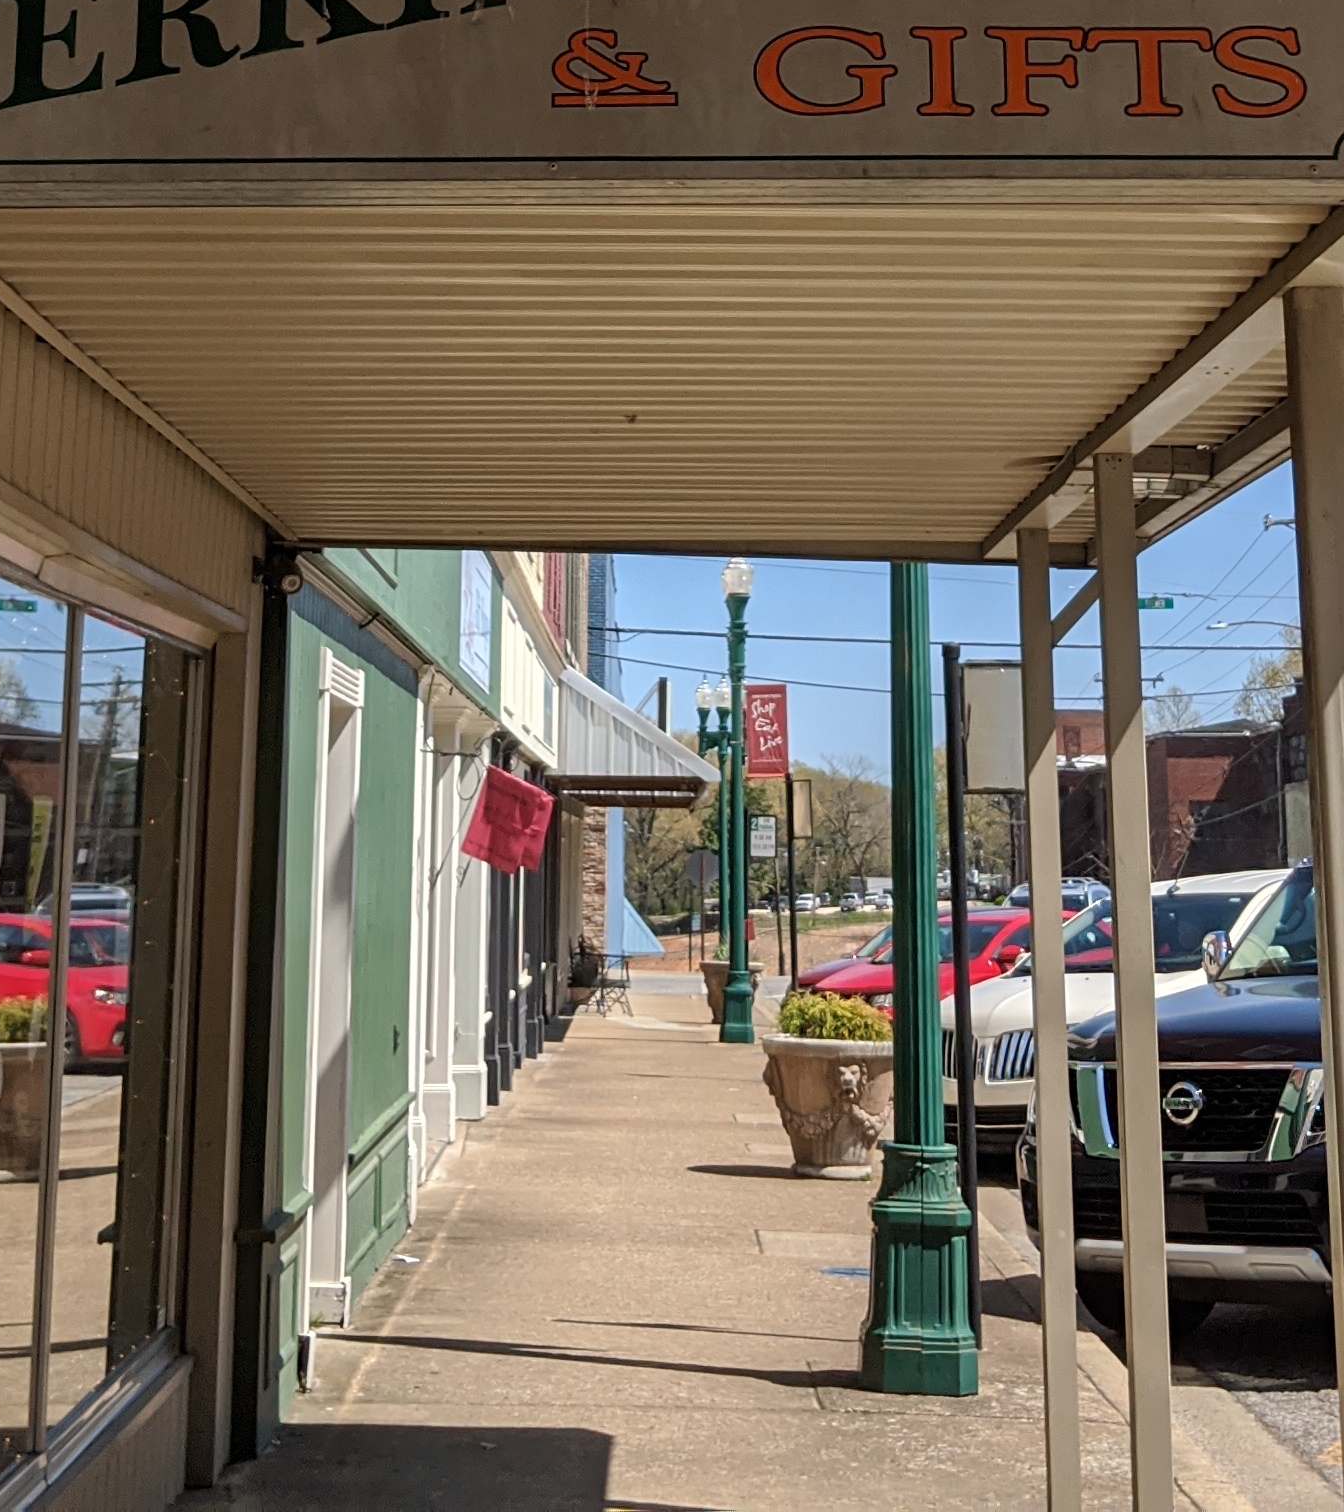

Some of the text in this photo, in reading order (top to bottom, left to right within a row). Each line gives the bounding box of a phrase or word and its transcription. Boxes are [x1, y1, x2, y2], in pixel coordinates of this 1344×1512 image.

[551, 25, 1308, 118] & GIFTS
[751, 701, 776, 719] Shop
[755, 717, 780, 735] Eat
[759, 735, 783, 751] Live
